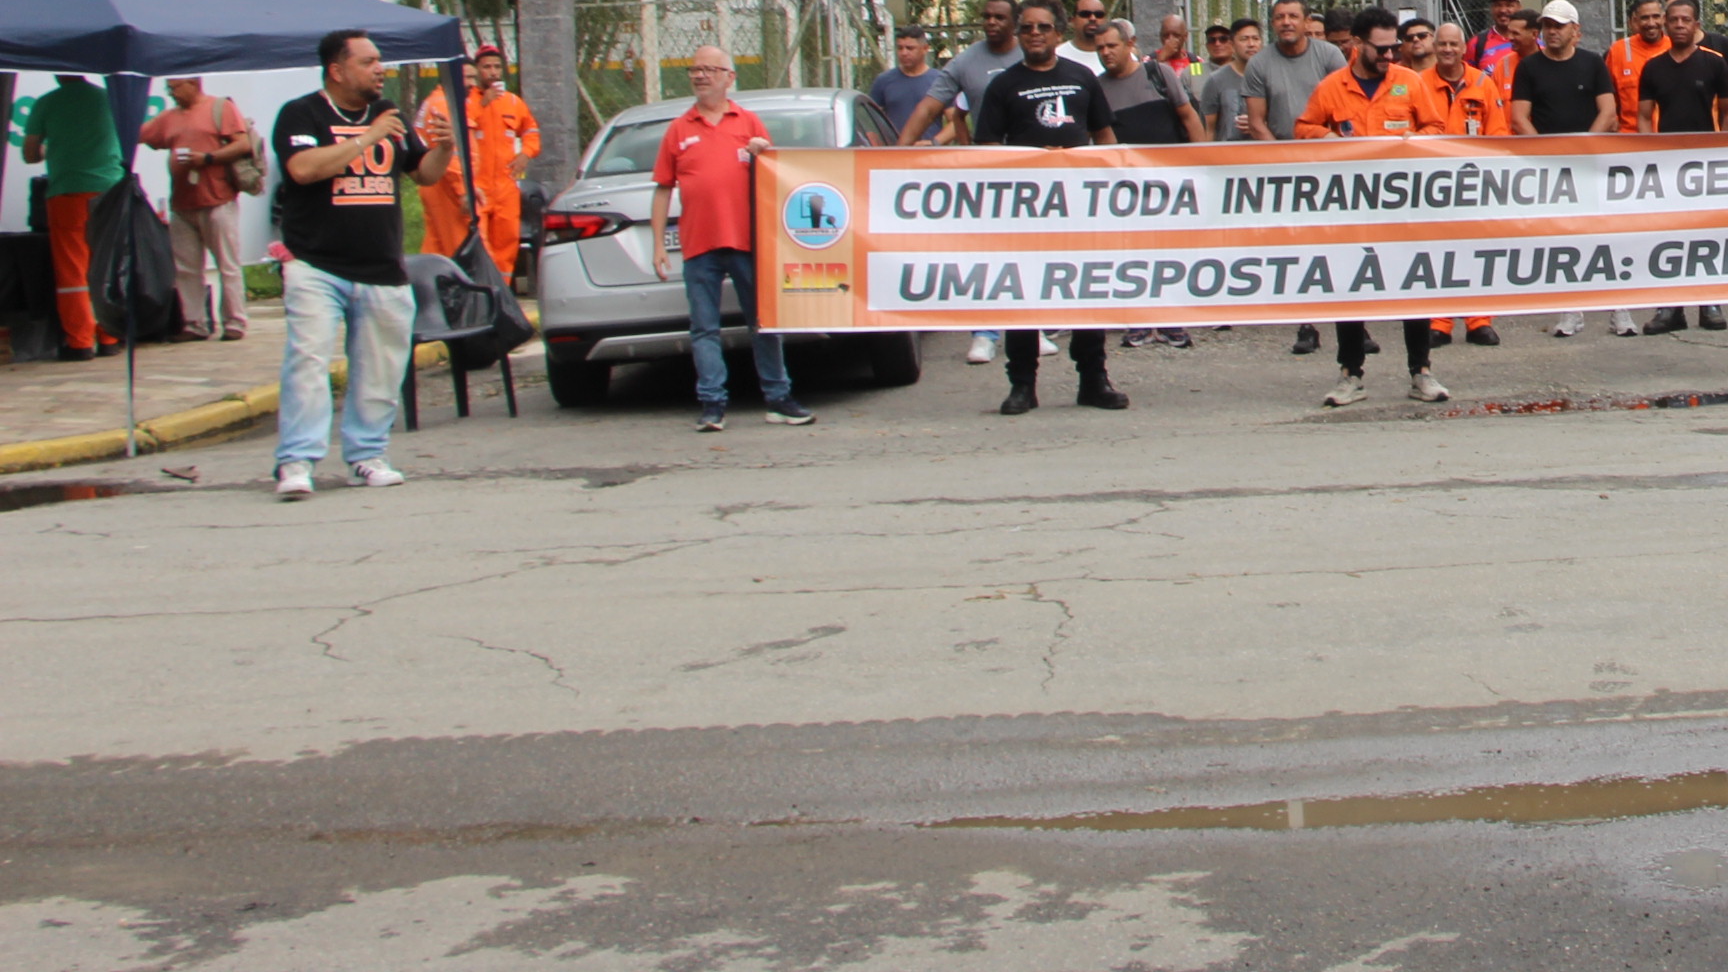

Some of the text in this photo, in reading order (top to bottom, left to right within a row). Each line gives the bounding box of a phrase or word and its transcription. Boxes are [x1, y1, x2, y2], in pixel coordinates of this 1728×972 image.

[332, 176, 395, 195] PELEGO
[894, 180, 1068, 219] CONTRA
[1083, 179, 1199, 217] TODA
[1221, 162, 1579, 214] INTRANSIGÊNCIA
[1606, 163, 1666, 201] DA
[783, 262, 849, 289] FNP
[898, 262, 1026, 302] UMA
[1039, 255, 1334, 301] RESPOSTA
[1349, 246, 1386, 292] À
[1400, 244, 1635, 290] ALTURA:
